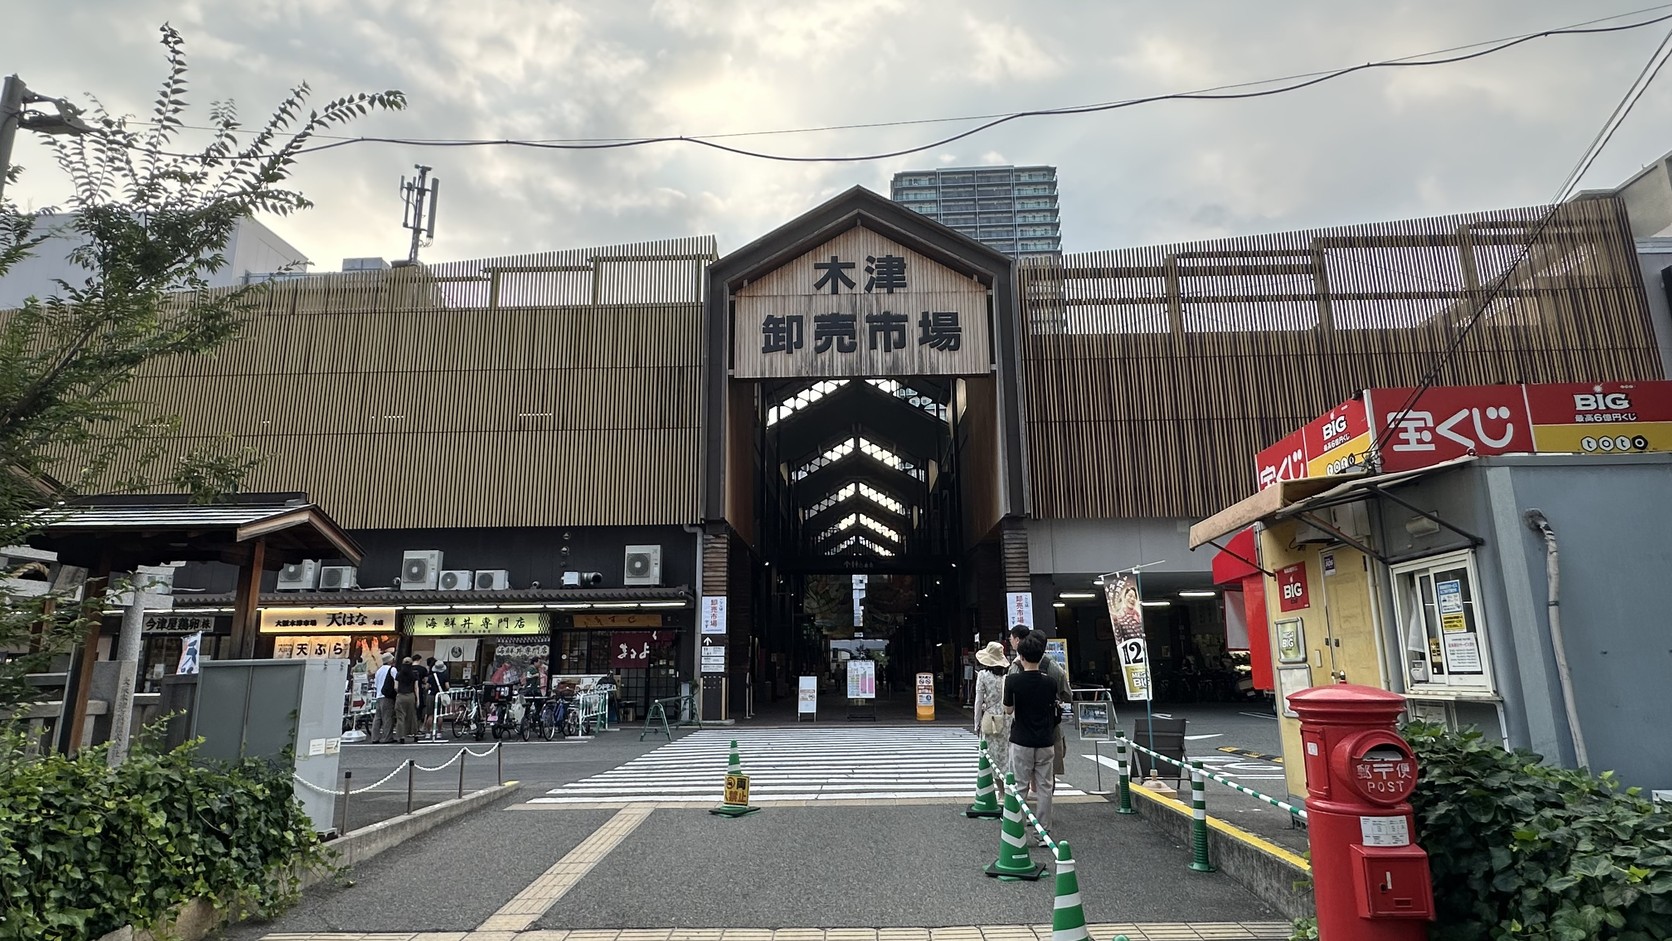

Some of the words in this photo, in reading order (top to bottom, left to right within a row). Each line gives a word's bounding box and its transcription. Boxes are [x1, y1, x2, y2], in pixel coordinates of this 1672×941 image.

[814, 255, 907, 294] 木津
[762, 311, 962, 354] 卸売市場
[1573, 393, 1630, 411] BIG
[1575, 413, 1637, 423] 最高6億円くじ
[1322, 415, 1347, 441] BIG
[1386, 406, 1514, 452] 宝くじ
[1582, 436, 1648, 451] toto
[1283, 582, 1303, 599] BIG
[326, 612, 368, 627] 天はな
[296, 643, 343, 656] 天ぷら
[1121, 641, 1144, 665] 12
[1367, 781, 1404, 792] POST
